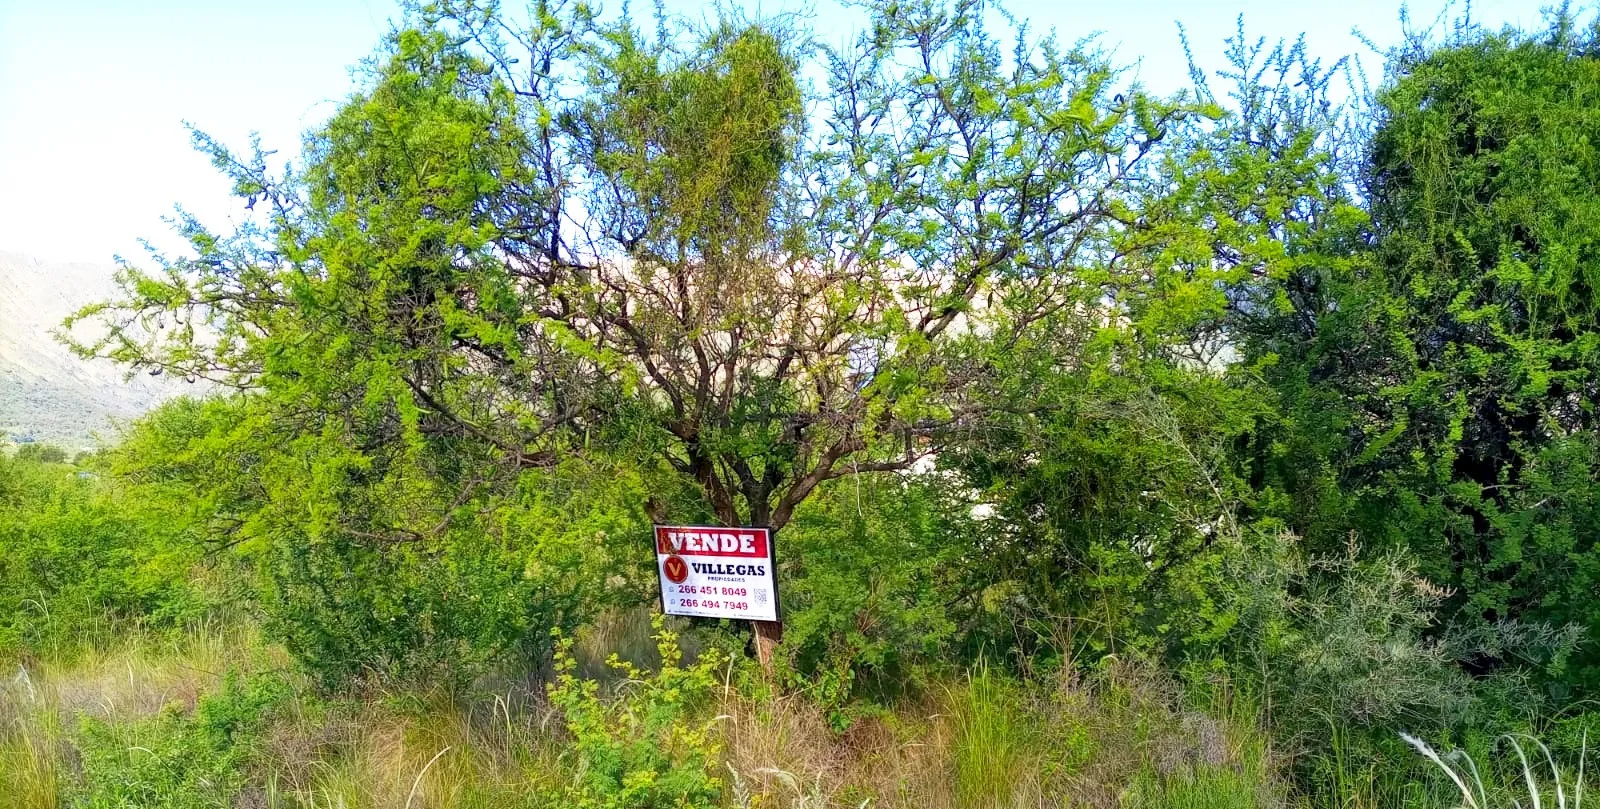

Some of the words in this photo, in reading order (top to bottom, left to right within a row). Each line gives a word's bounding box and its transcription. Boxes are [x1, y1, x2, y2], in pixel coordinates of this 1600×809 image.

[668, 532, 756, 553] VENDE
[692, 562, 766, 576] VILLEGAS
[678, 585, 697, 594] 266
[700, 586, 718, 595] 451
[721, 587, 747, 597] 8049
[680, 598, 699, 608] 266
[701, 599, 720, 609] 494
[724, 601, 748, 611] 7949
